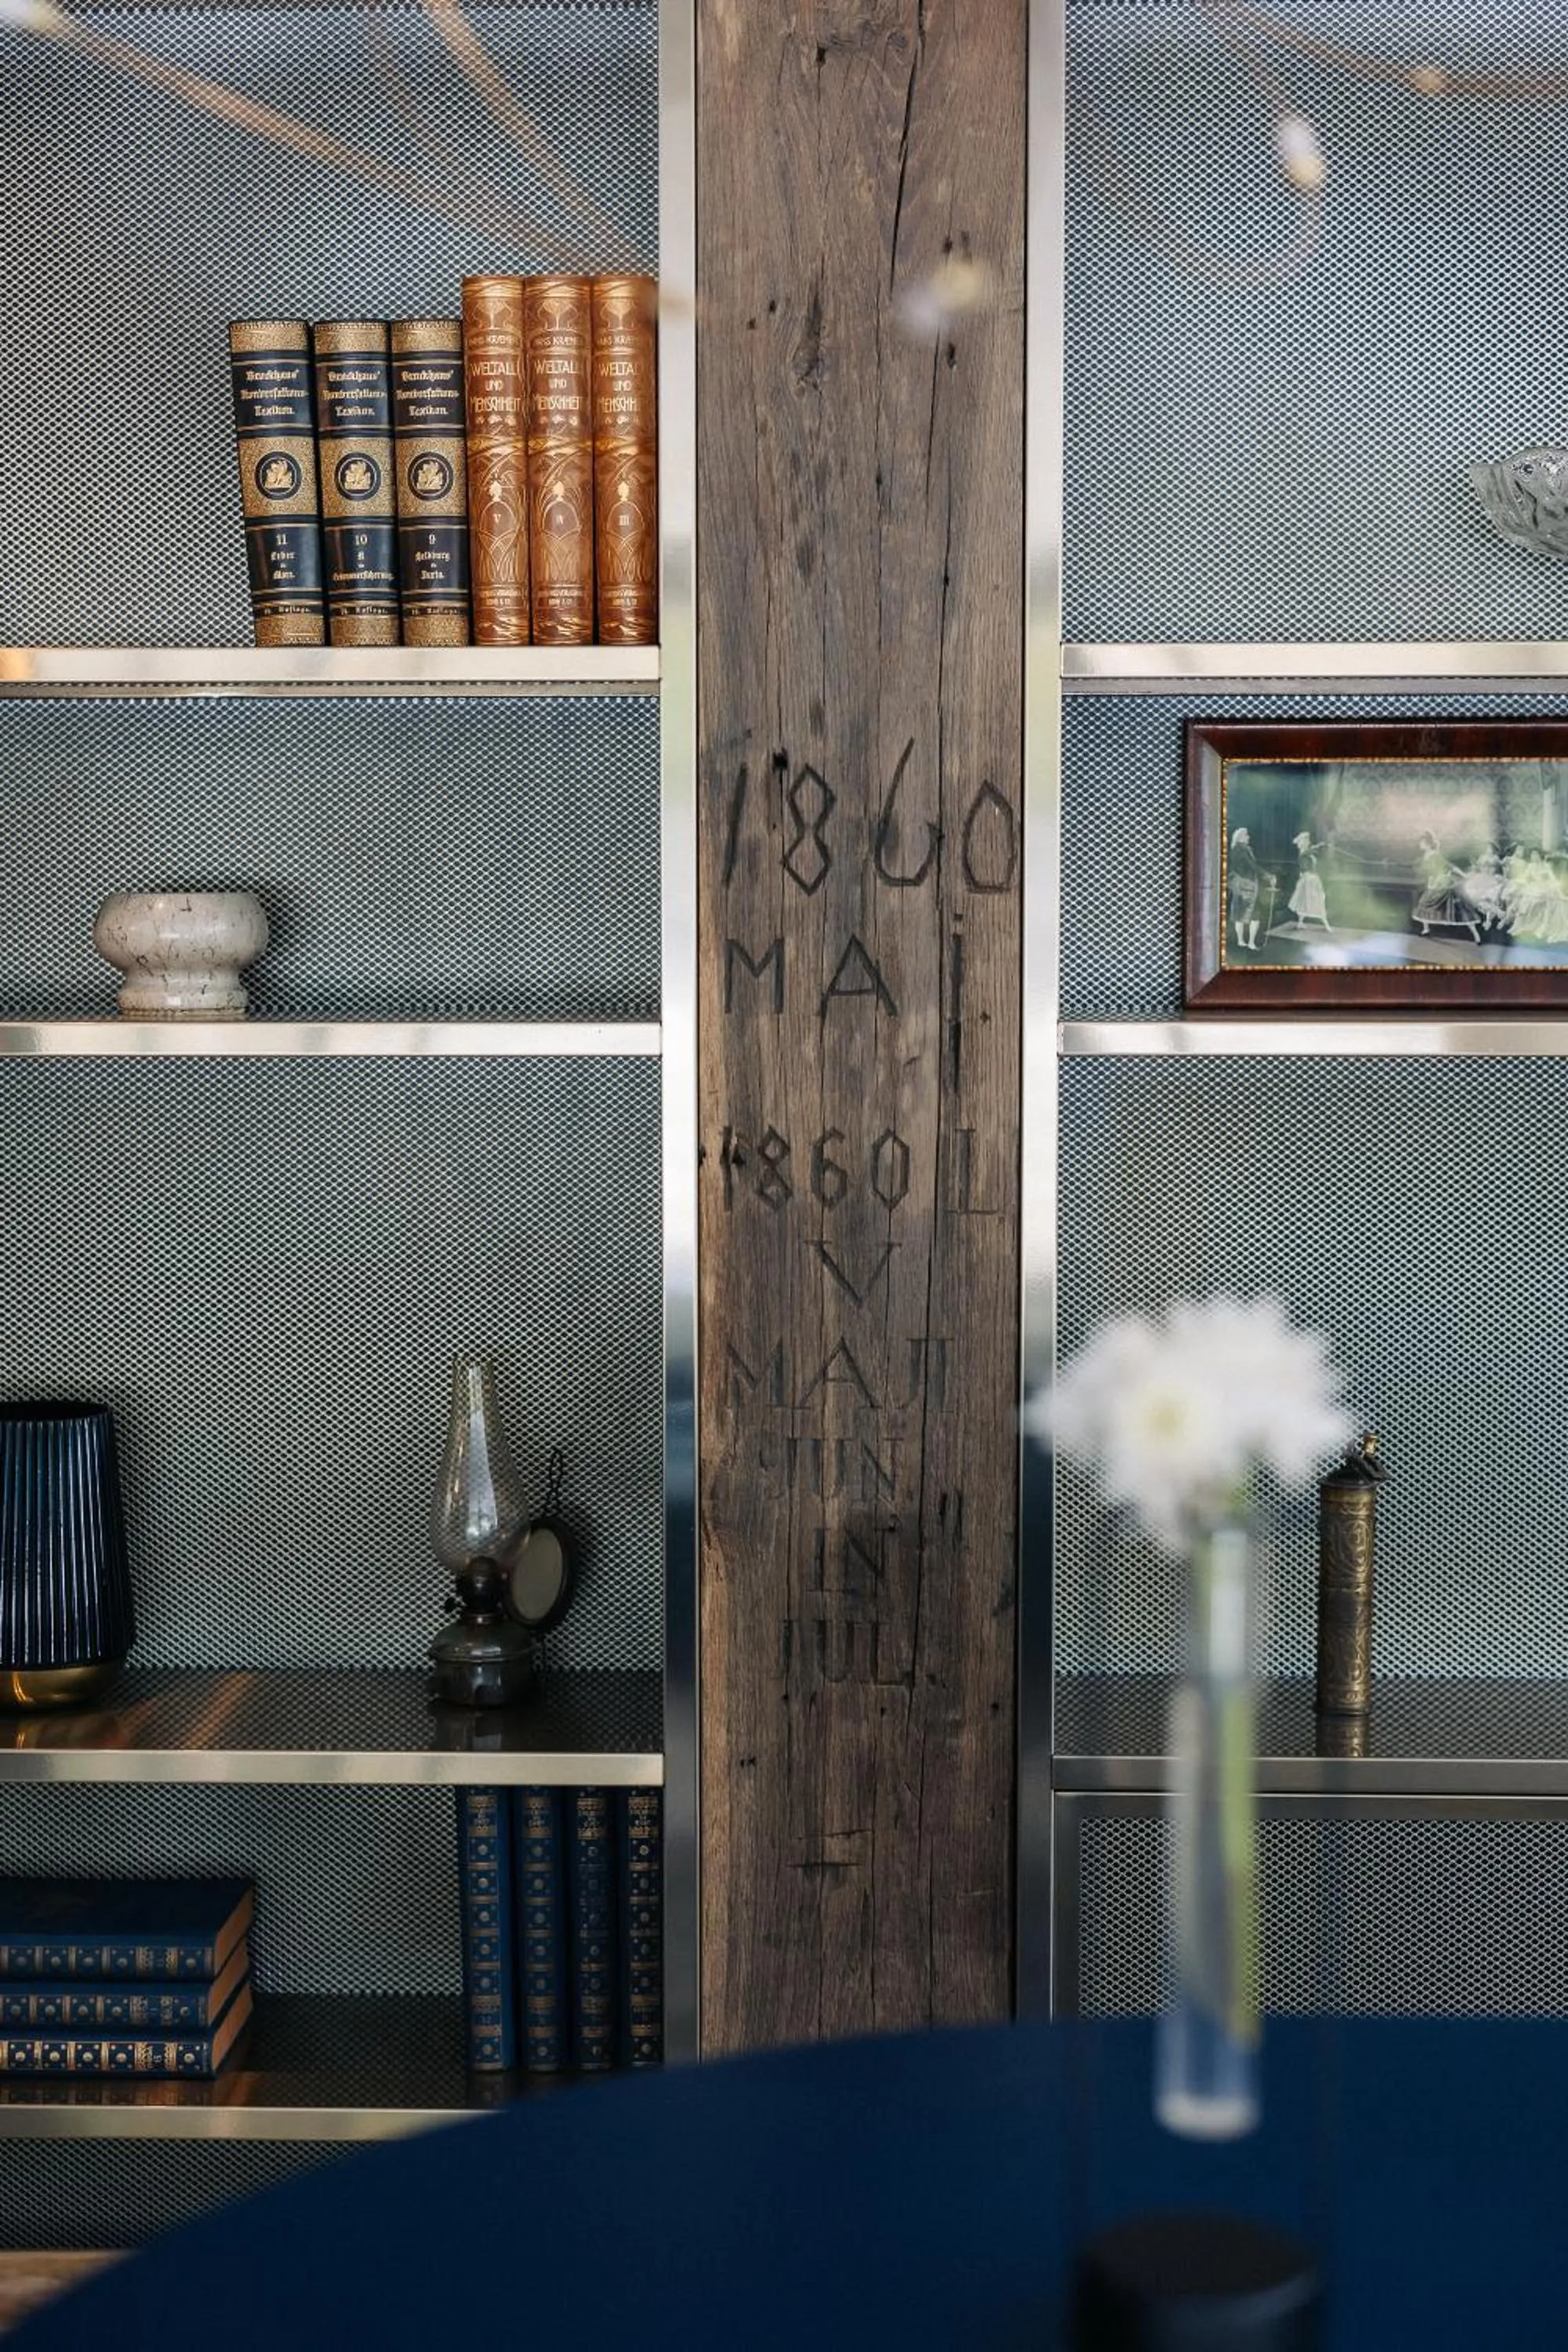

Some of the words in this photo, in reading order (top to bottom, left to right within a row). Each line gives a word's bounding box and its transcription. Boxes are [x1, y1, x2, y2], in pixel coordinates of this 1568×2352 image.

[275, 533, 288, 546] 11
[354, 534, 368, 546] 10
[428, 534, 437, 546] 9
[720, 737, 1018, 896] 1860
[721, 1125, 913, 1213] 1860
